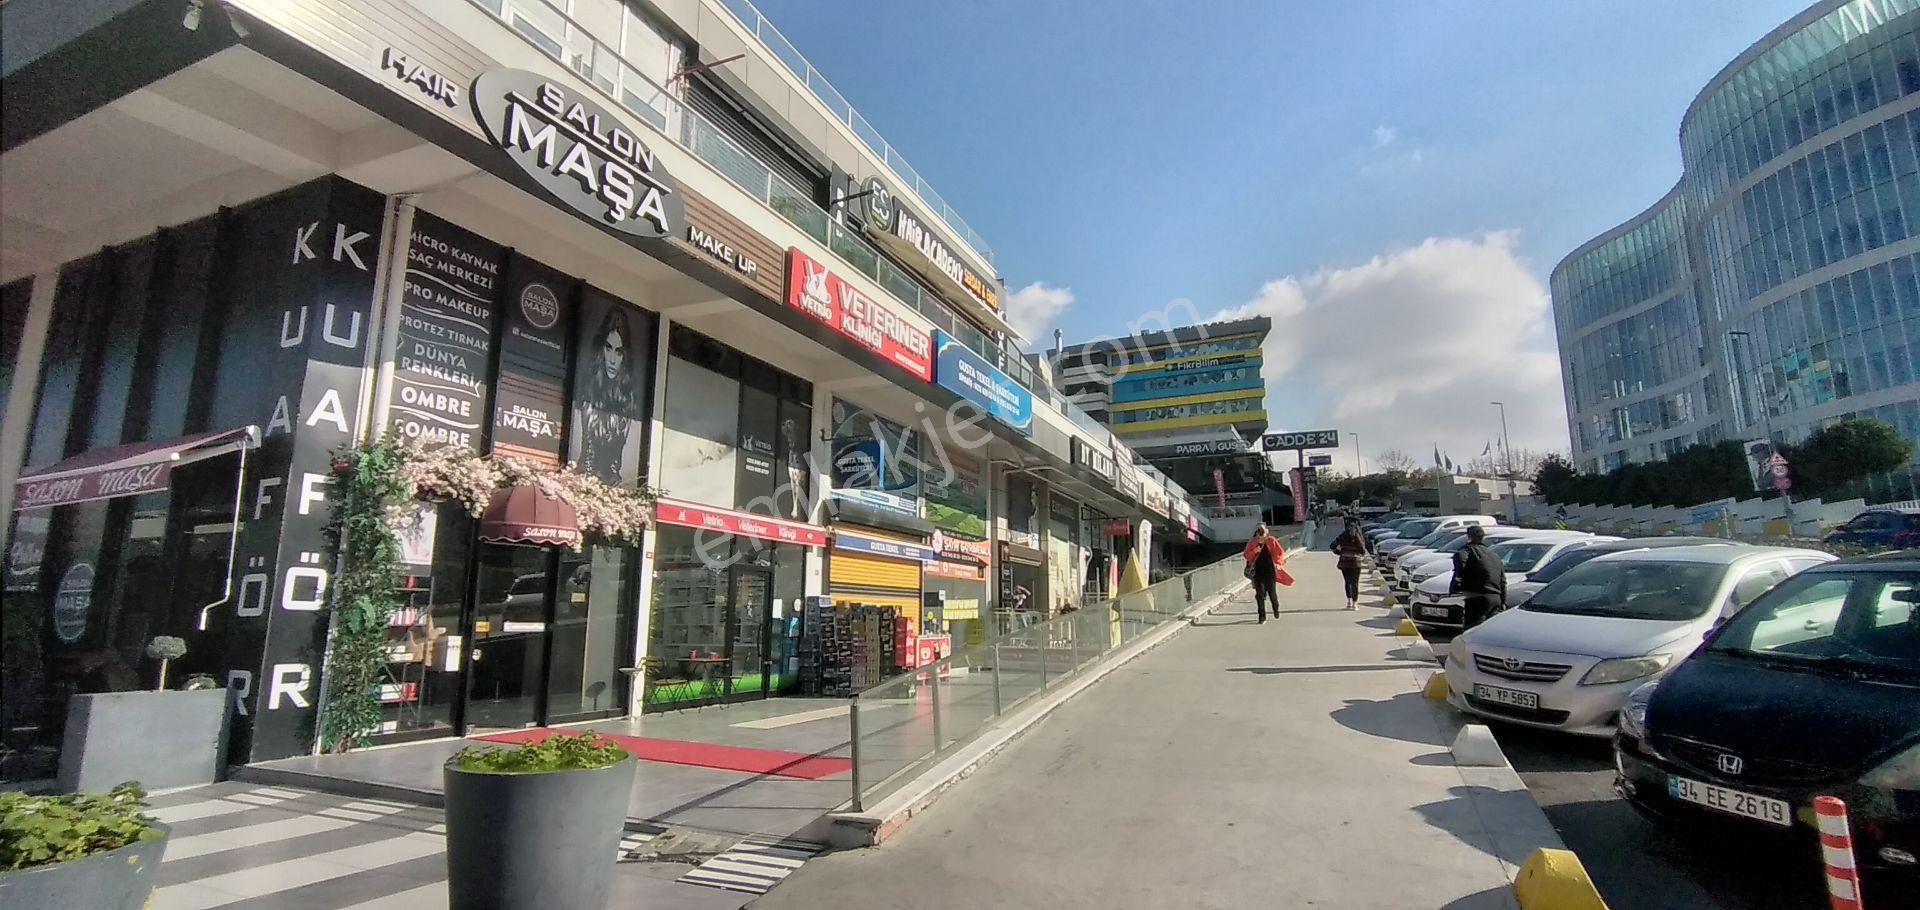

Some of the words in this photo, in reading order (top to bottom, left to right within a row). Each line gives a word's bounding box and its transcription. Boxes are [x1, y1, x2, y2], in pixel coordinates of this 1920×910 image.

[382, 47, 460, 107] HAIR
[541, 82, 655, 172] SALON
[506, 103, 671, 231] MAŞA
[451, 248, 498, 275] KAYNAK
[688, 226, 735, 265] MAKE
[737, 253, 757, 275] UP
[924, 231, 963, 284] ACADEMY
[408, 248, 434, 267] SAÇ
[437, 260, 493, 290] MERKEZİ
[404, 281, 431, 300] PRO
[436, 293, 490, 319] MAKEUP
[399, 314, 444, 337] PROTEZ
[447, 330, 489, 351] TIRNAK
[401, 356, 475, 388] RENKLERİ
[414, 343, 467, 369] DÜNYA
[401, 387, 471, 417] OMBRE
[513, 404, 547, 420] SALON
[503, 414, 553, 438] MAŞA
[1264, 433, 1317, 448] CADDE
[1318, 431, 1336, 444] 24
[1176, 444, 1210, 455] PARRA
[701, 512, 724, 527] Vetrio
[1480, 686, 1491, 699] 34
[1497, 689, 1509, 702] YP
[1511, 691, 1536, 707] 5853
[1680, 780, 1698, 800] 34
[1706, 786, 1728, 809] EE
[1734, 793, 1783, 821] 2619
